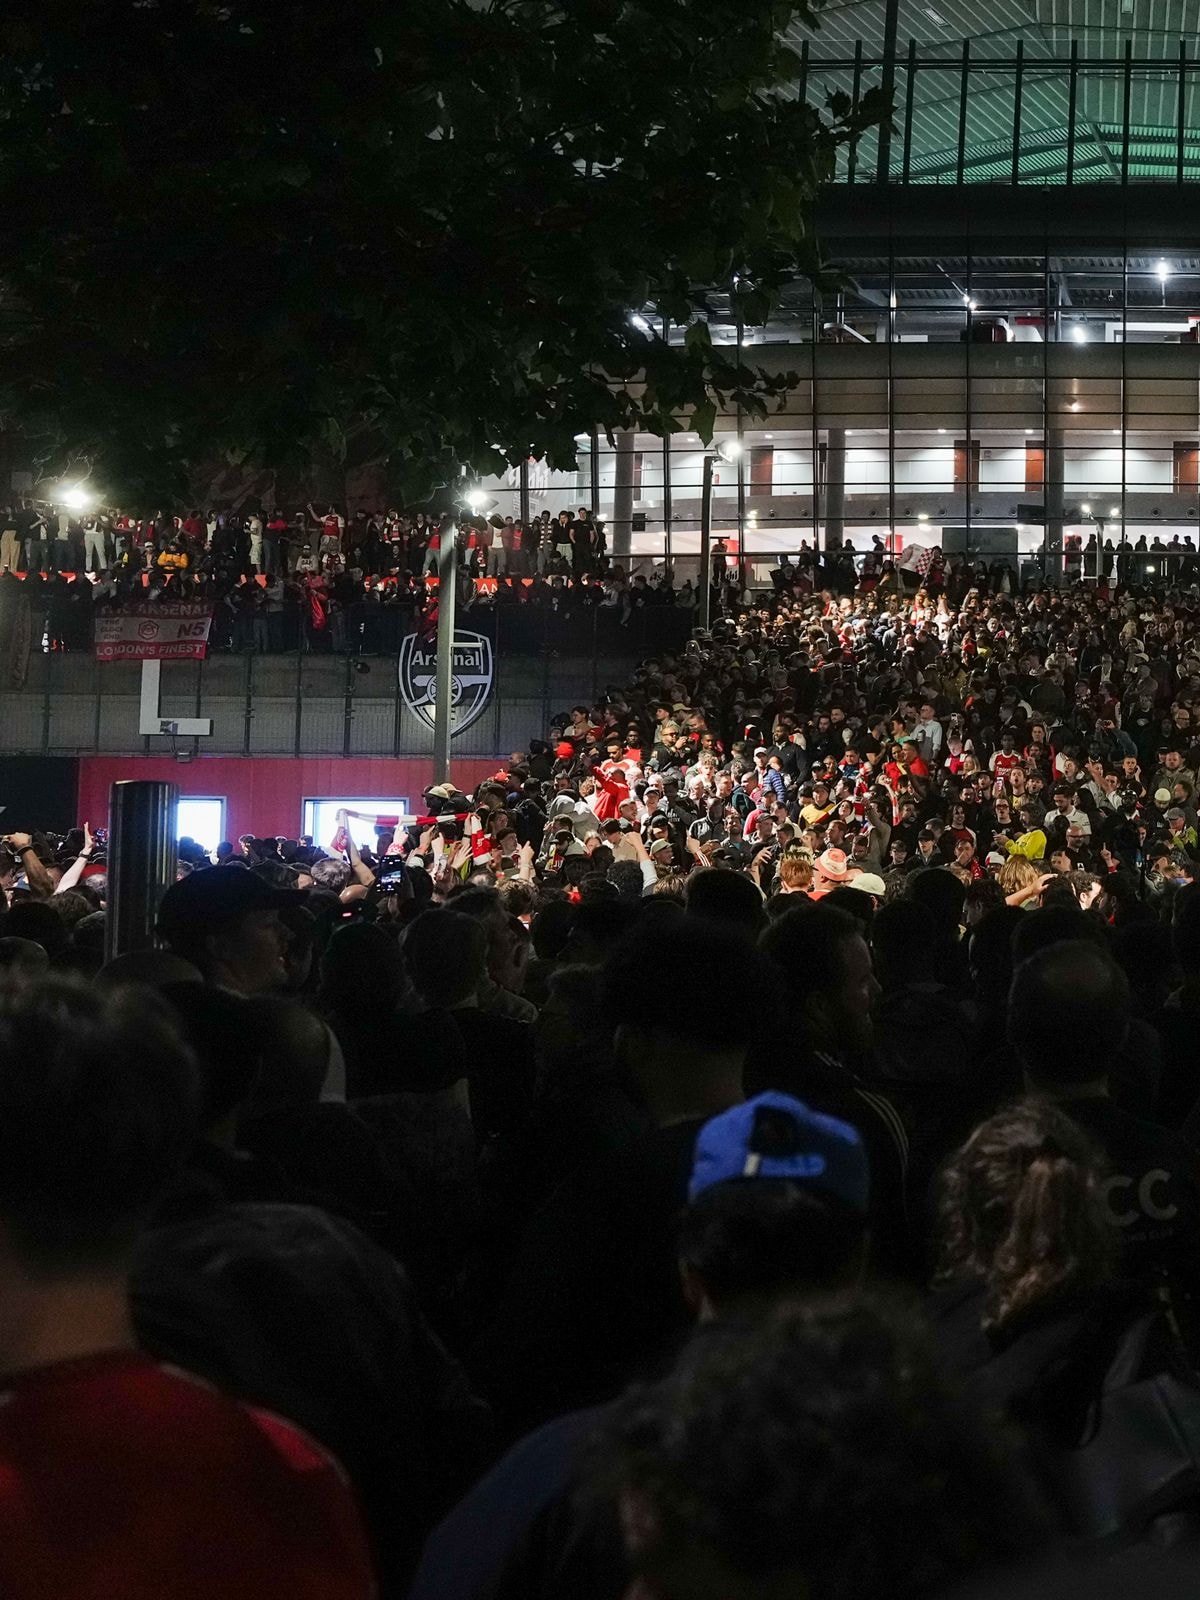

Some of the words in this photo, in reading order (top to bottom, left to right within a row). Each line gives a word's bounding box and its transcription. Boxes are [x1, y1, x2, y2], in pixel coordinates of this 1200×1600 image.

[177, 622, 205, 638] N5
[159, 643, 203, 655] FINEST
[410, 650, 480, 667] Arsnal
